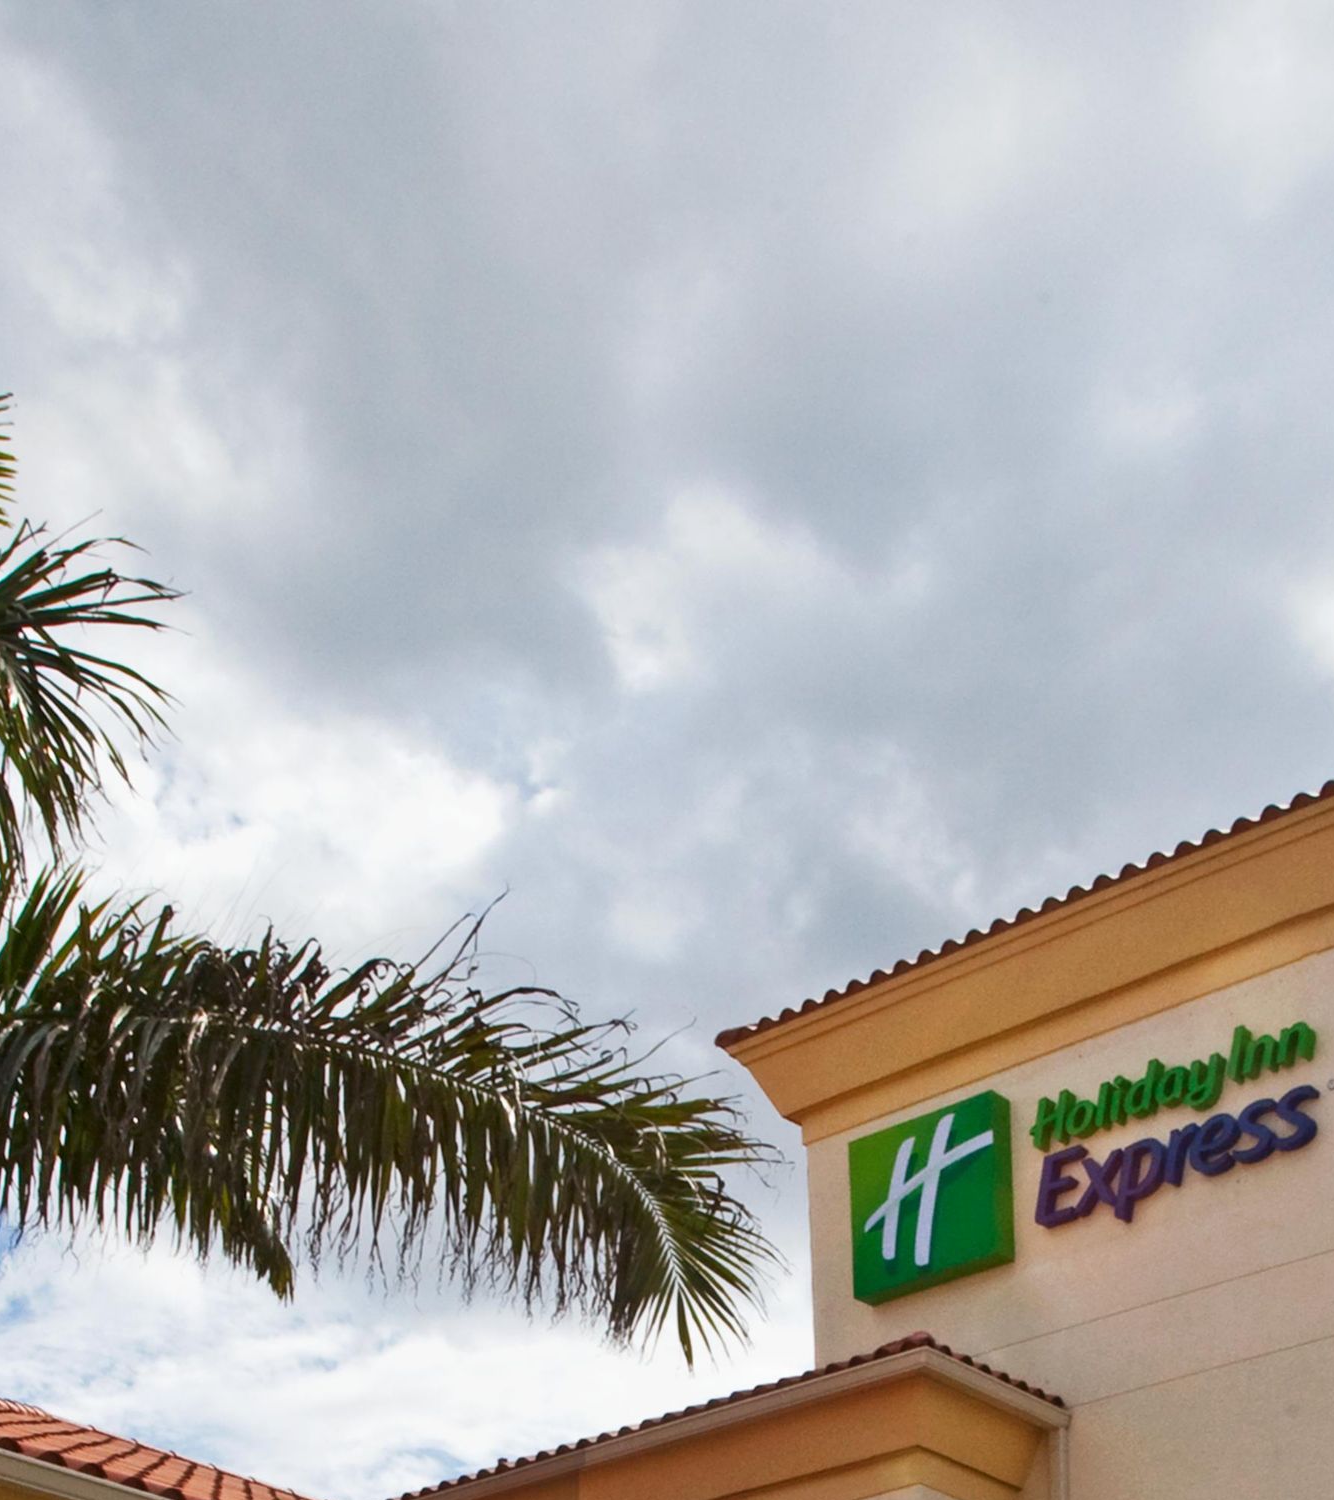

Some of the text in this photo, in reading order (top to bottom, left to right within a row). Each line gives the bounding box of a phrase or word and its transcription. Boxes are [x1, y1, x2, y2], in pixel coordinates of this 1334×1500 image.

[1029, 1021, 1317, 1152] Holiday Inn
[1035, 1084, 1321, 1229] Express
